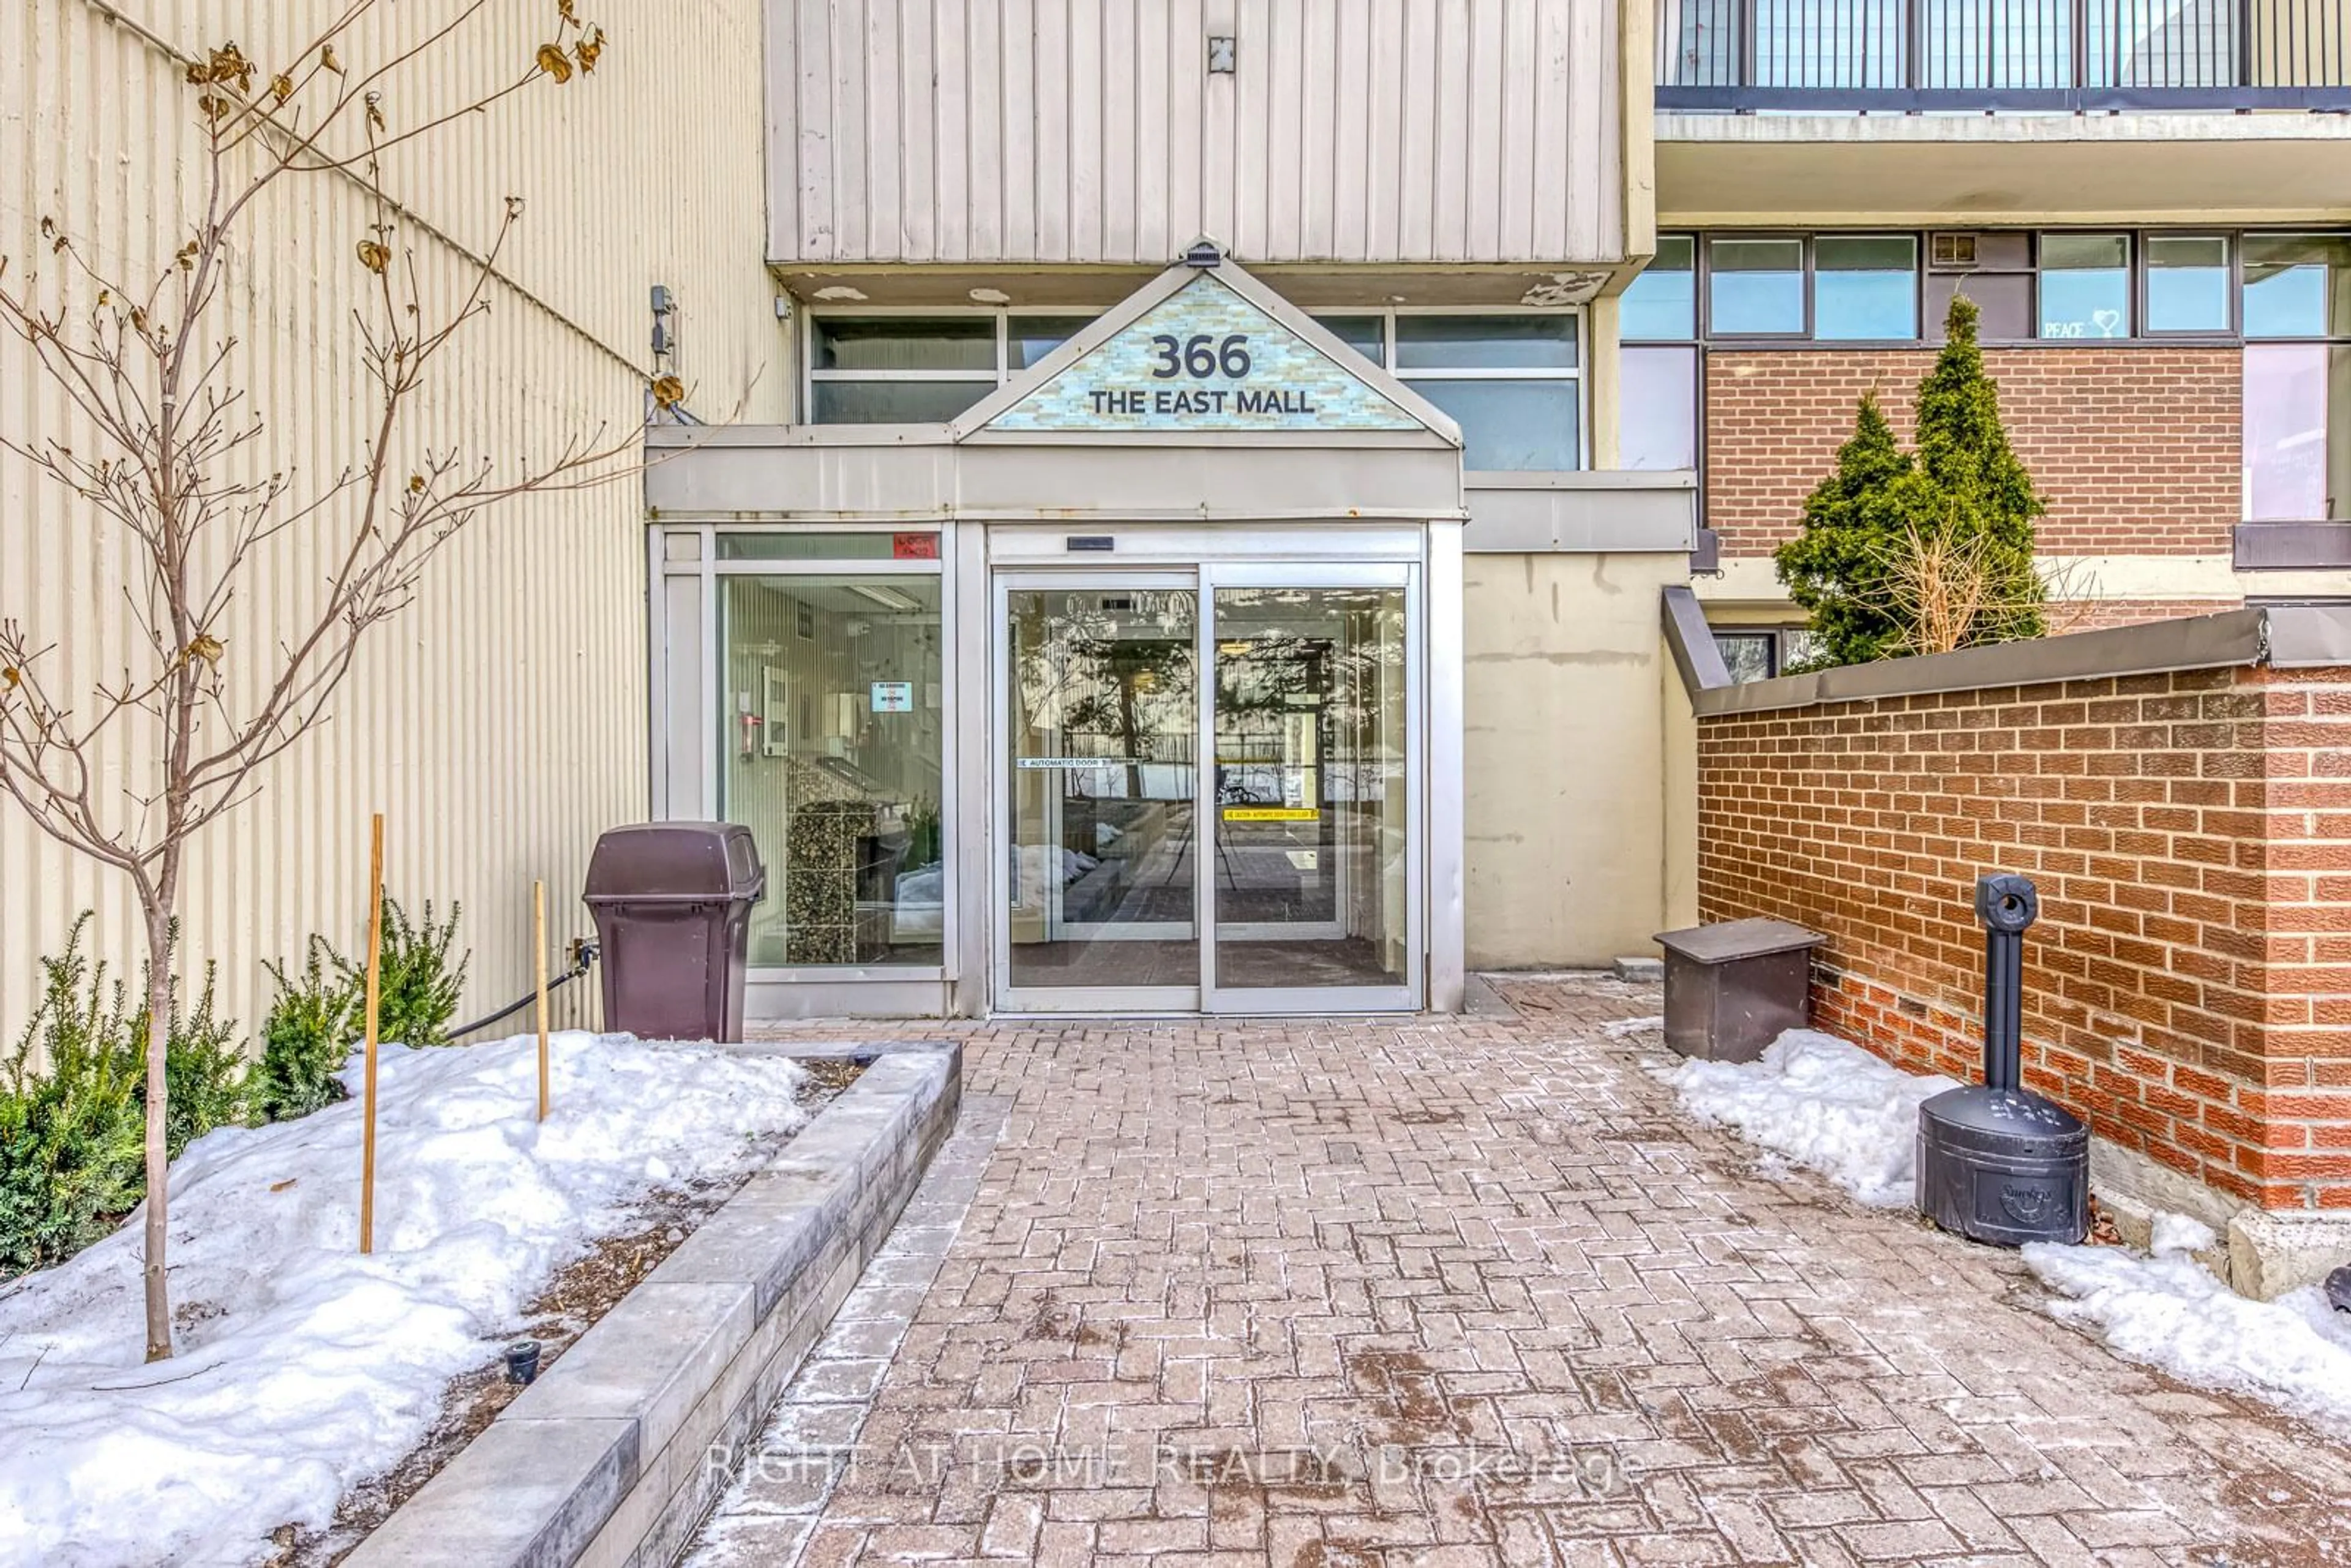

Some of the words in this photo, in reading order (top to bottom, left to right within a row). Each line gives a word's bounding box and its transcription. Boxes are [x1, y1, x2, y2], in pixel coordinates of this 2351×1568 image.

[2045, 322, 2085, 339] PEACE
[1152, 335, 1251, 379] 366
[1089, 391, 1146, 414] THE
[1155, 391, 1228, 414] EAST
[1237, 391, 1316, 414] MALL
